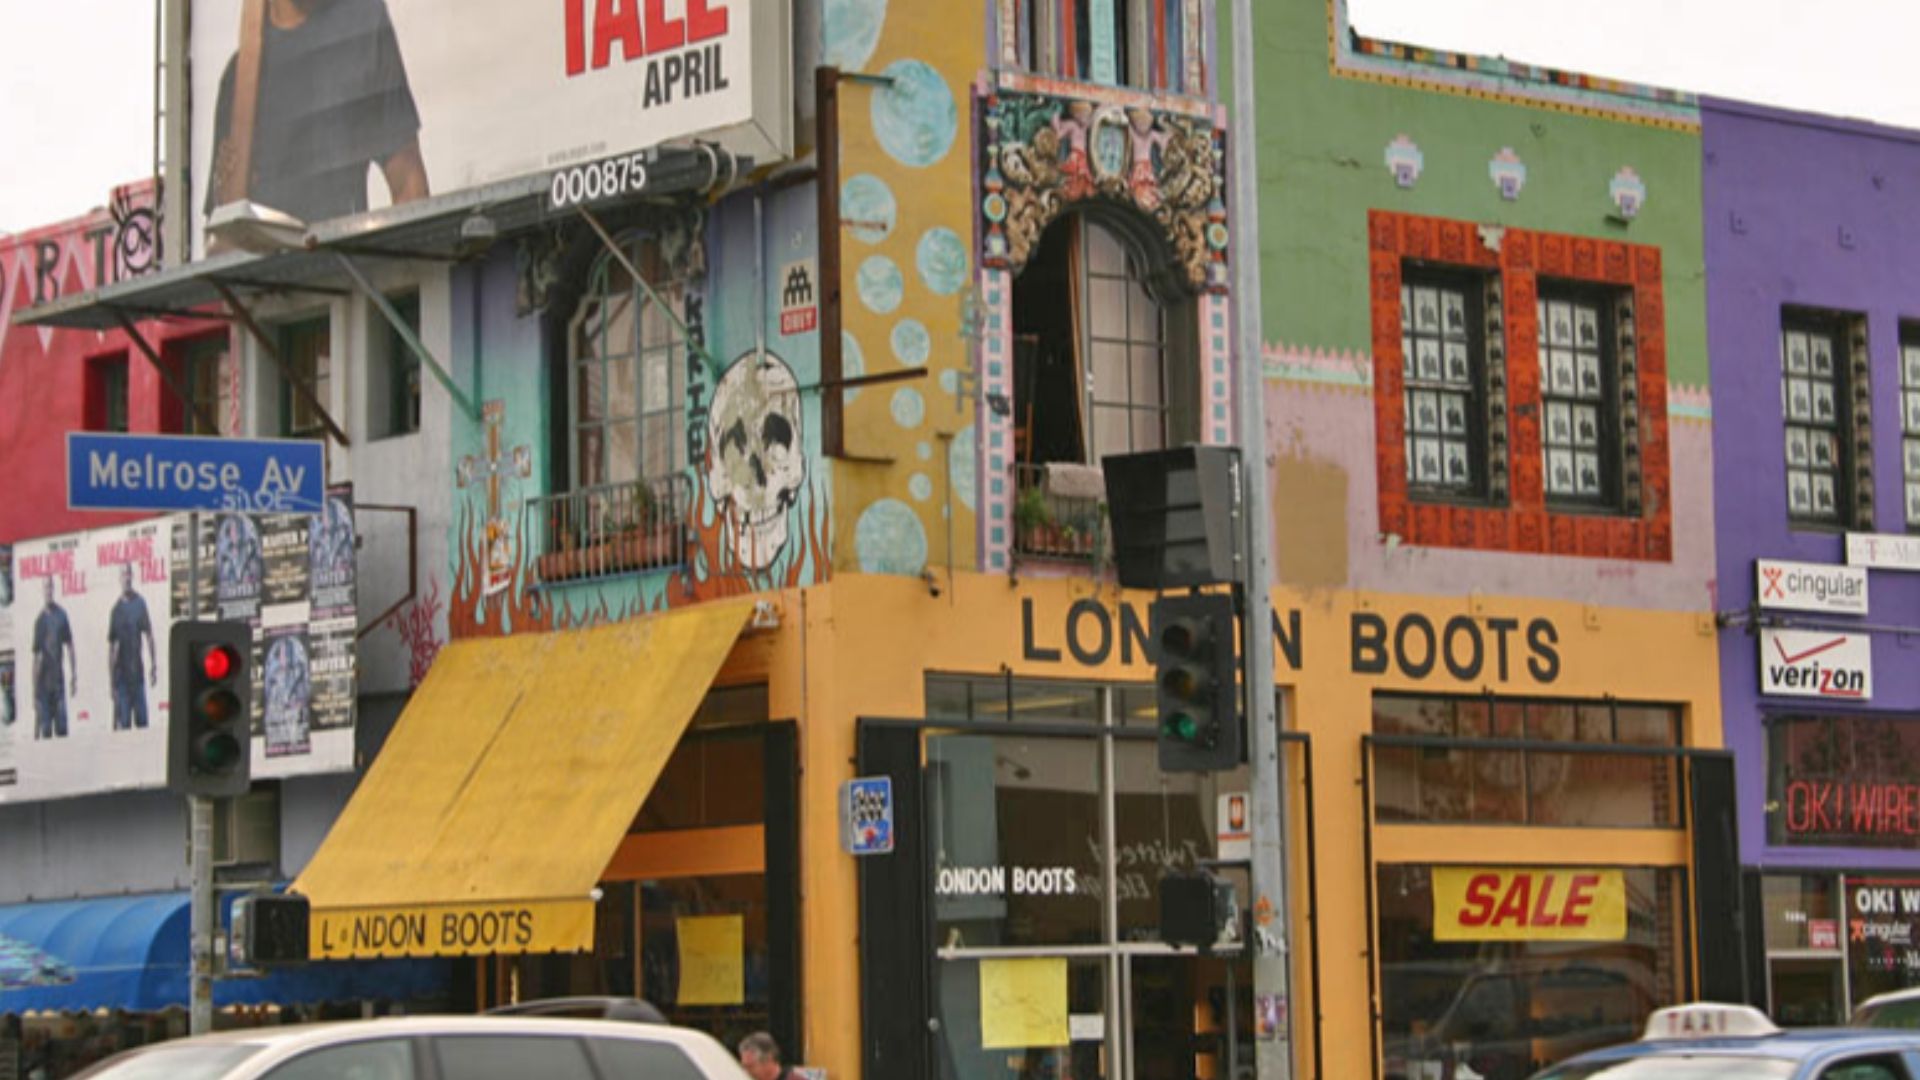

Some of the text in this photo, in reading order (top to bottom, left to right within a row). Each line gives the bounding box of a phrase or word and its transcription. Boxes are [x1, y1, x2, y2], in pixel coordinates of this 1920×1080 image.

[564, 0, 728, 77] TALL
[643, 45, 729, 109] APRIL
[552, 153, 646, 206] 000875
[88, 451, 304, 493] Melrose Av
[19, 549, 75, 580] WALKING
[97, 537, 154, 567] WALKING
[62, 571, 87, 597] TALL
[140, 557, 167, 584] TALL
[1787, 570, 1863, 601] cingular
[1022, 596, 1560, 684] LONN BOOTS
[1770, 661, 1864, 696] verizon
[1786, 780, 1920, 834] OK! WIRE
[1012, 867, 1076, 893] BOOTS
[1458, 872, 1601, 928] SALE
[1856, 888, 1896, 913] OK!
[440, 909, 534, 947] BOOTS
[1863, 921, 1911, 942] cingular
